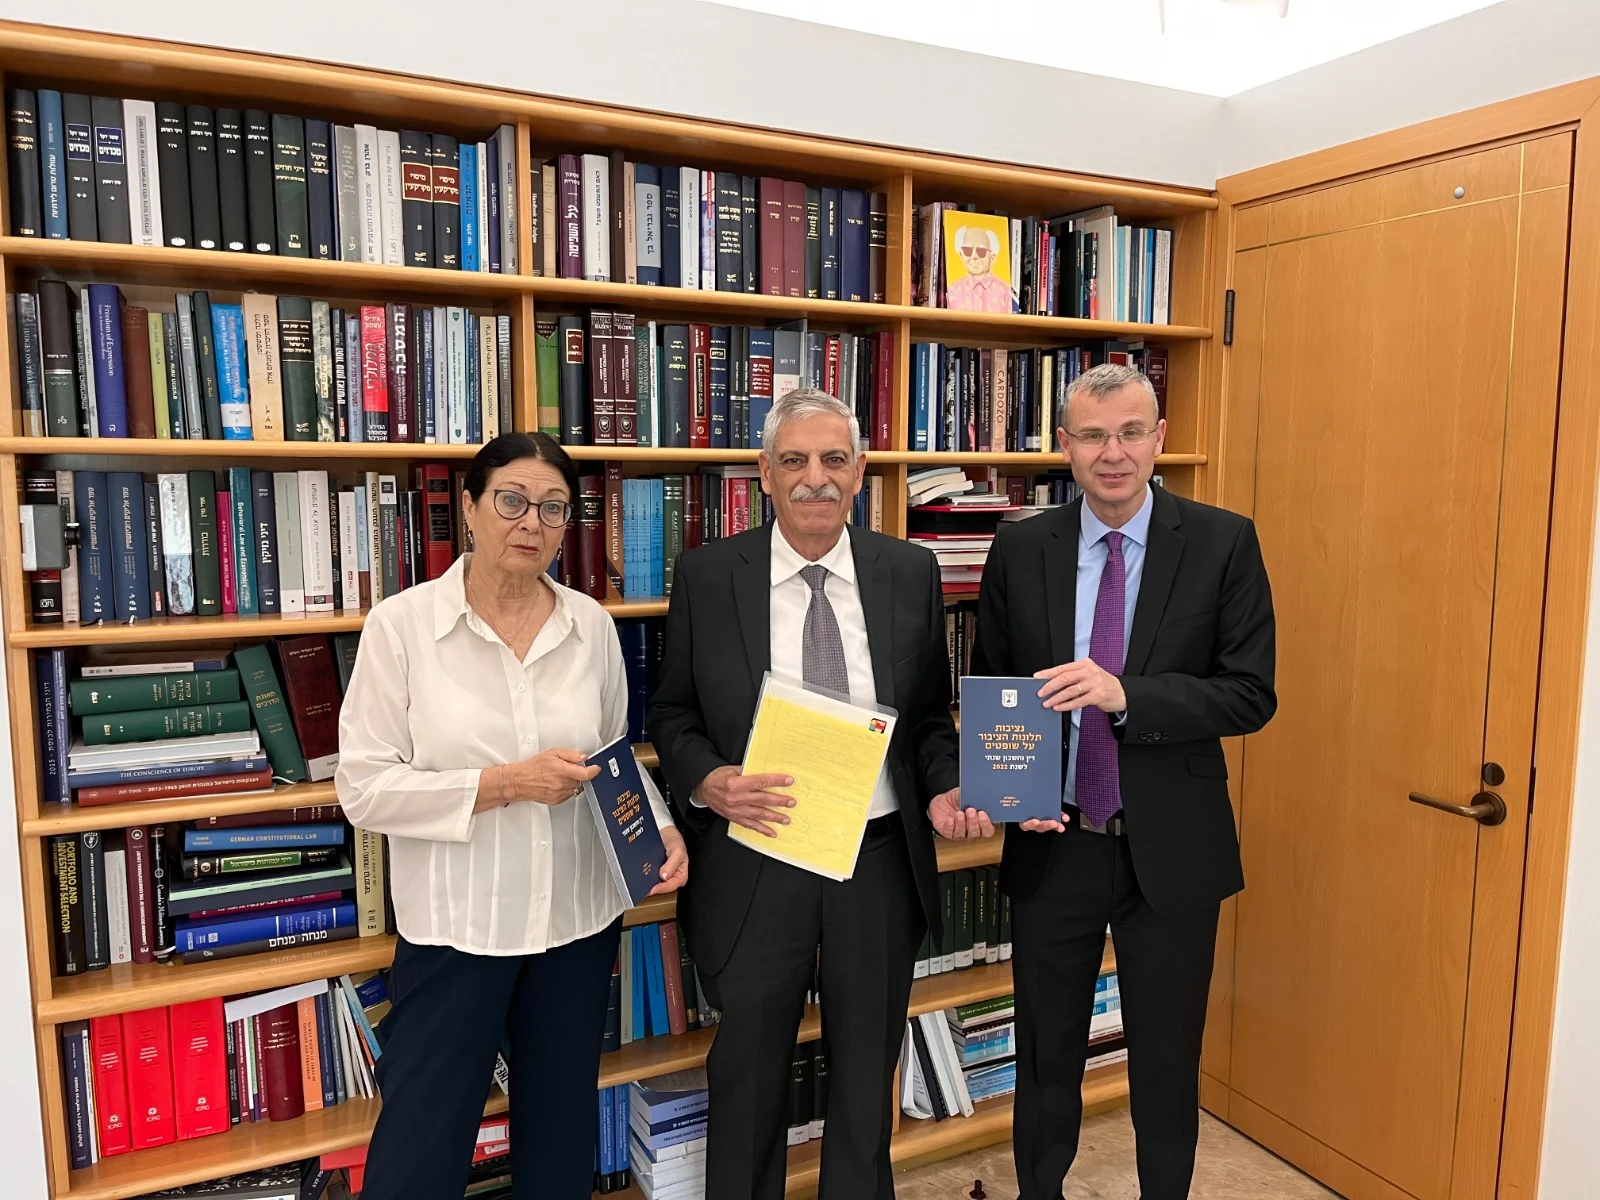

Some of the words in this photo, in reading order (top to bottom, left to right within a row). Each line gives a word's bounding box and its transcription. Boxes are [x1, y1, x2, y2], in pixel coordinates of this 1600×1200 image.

[68, 143, 90, 153] מכרזים
[99, 146, 122, 157] מכרזים
[564, 204, 579, 219] על
[646, 213, 654, 241] גבריאל
[568, 222, 579, 257] השפיטה
[647, 244, 654, 255] בך
[103, 304, 112, 333] Freedom
[180, 315, 189, 334] Law
[105, 333, 112, 341] of
[26, 353, 31, 364] ON
[105, 341, 114, 376] Expression
[335, 347, 344, 363] הסוד
[336, 364, 344, 379] טמון
[364, 343, 377, 389] הסלולרי
[337, 380, 345, 405] באנשים
[88, 500, 97, 520] אליקים
[123, 500, 132, 520] אליקים
[330, 498, 338, 525] JUDGE'S
[90, 520, 99, 550] רובינשטיין
[124, 520, 134, 550] רובינשטיין
[260, 522, 269, 538] דיני
[201, 532, 210, 556] בוררות
[237, 502, 245, 533] Behavioral
[241, 557, 249, 588] Economics
[261, 540, 273, 564] נזיקין
[256, 698, 280, 709] הדרכים
[995, 724, 1025, 732] נציבות
[47, 729, 55, 751] לכנסת
[978, 733, 1008, 741] הציבור
[1011, 732, 1042, 741] תלונות
[1023, 741, 1035, 750] על
[1003, 755, 1025, 763] וחשבון
[1026, 755, 1036, 763] דין
[133, 768, 172, 777] CONSCIENCE
[616, 790, 631, 804] נציבות
[617, 809, 635, 826] שופטים
[230, 834, 255, 842] GERMAN
[256, 833, 302, 842] CONSTITUTIONAL
[58, 842, 69, 891] INVESTMENT
[66, 841, 77, 885] PORTFOLIO
[69, 886, 78, 904] AND
[61, 892, 71, 934] SELECTION
[301, 930, 328, 942] מנחה
[195, 1104, 210, 1112] ICRC
[107, 1122, 122, 1130] ICRC
[146, 1115, 161, 1123] ICRC
